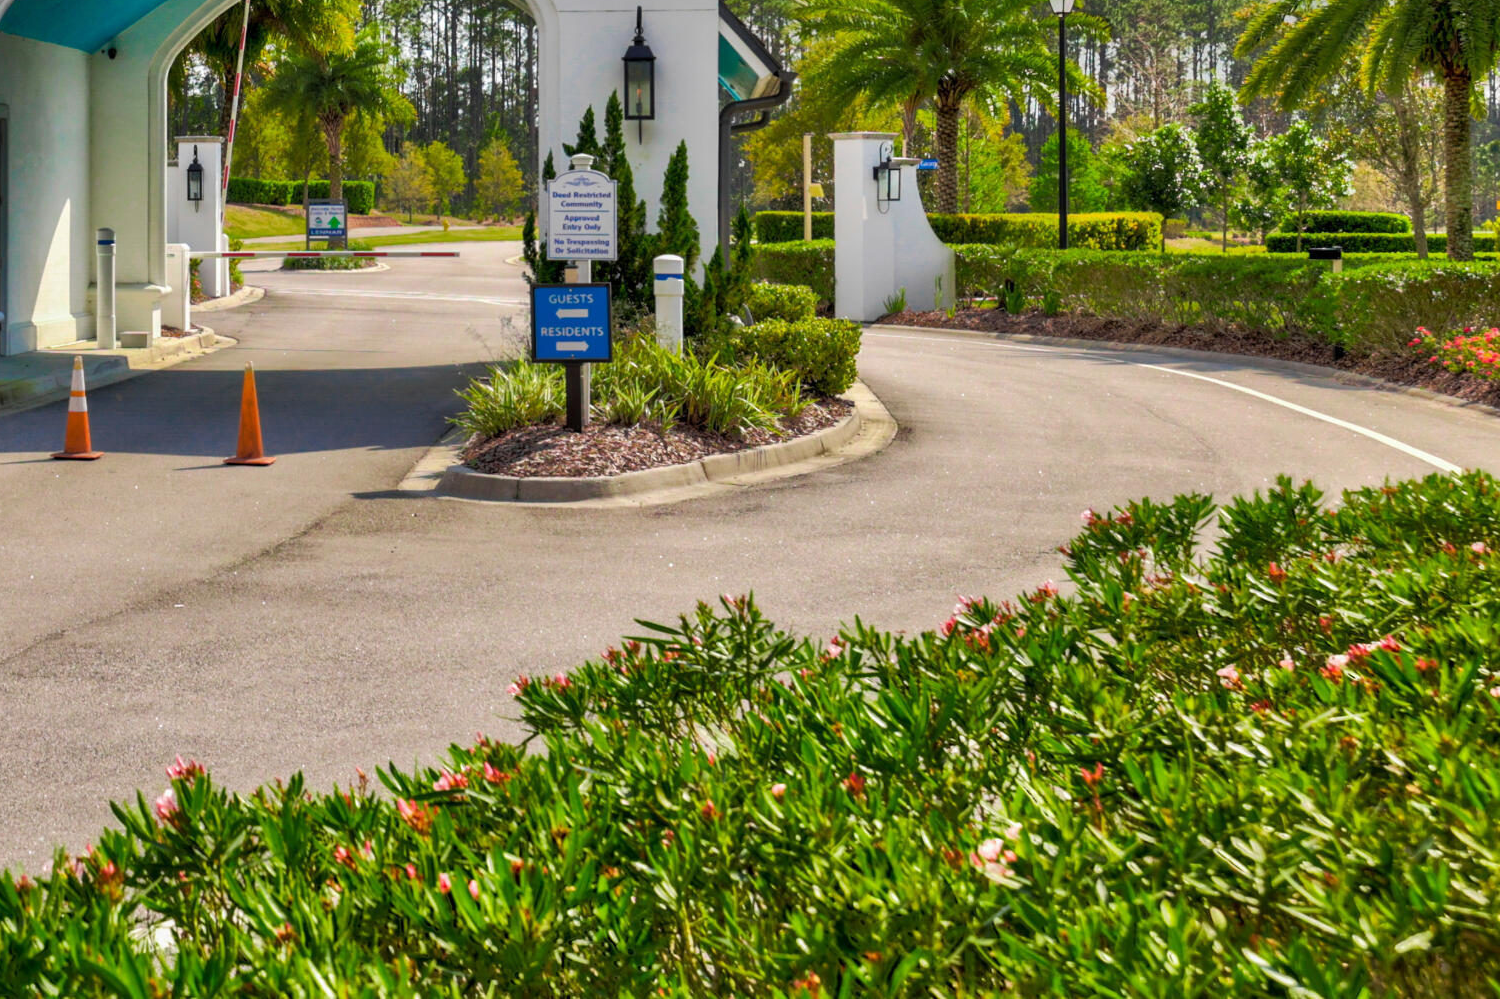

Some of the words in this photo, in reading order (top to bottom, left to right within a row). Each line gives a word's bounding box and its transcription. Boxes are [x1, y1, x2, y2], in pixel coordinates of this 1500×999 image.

[560, 200, 603, 209] Community
[564, 214, 600, 222] Approved
[562, 223, 582, 231] Entry
[584, 223, 601, 231] Only
[566, 238, 610, 247] Trespassing
[548, 293, 594, 304] GUESTS
[540, 326, 604, 337] RESIDENTS
